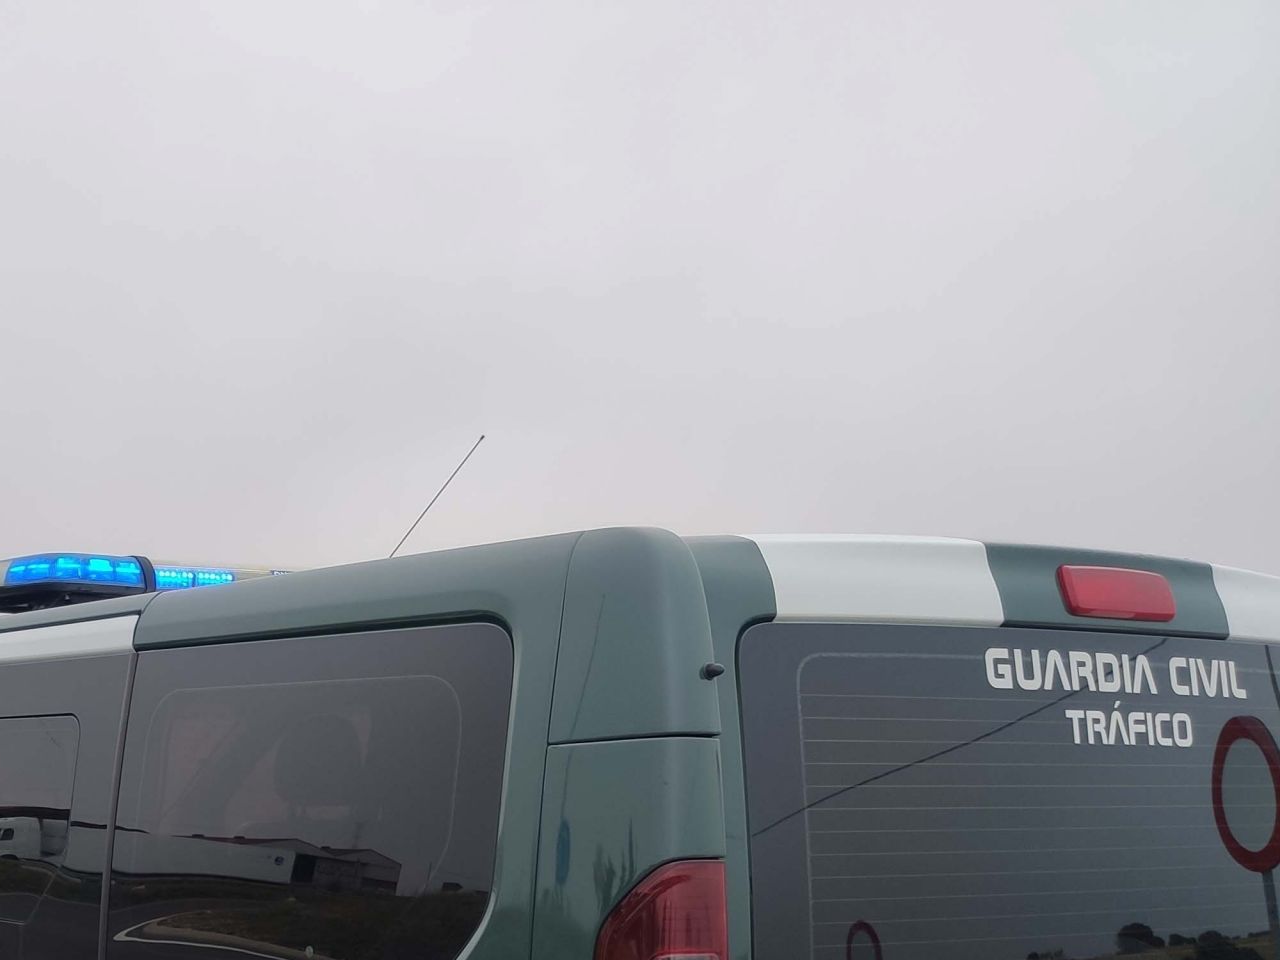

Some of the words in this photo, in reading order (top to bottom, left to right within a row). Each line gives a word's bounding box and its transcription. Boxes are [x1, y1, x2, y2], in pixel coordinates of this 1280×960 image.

[984, 647, 1158, 694] GUARDIA
[1169, 656, 1247, 699] CIVIL
[1065, 700, 1193, 747] TRÁFICO
